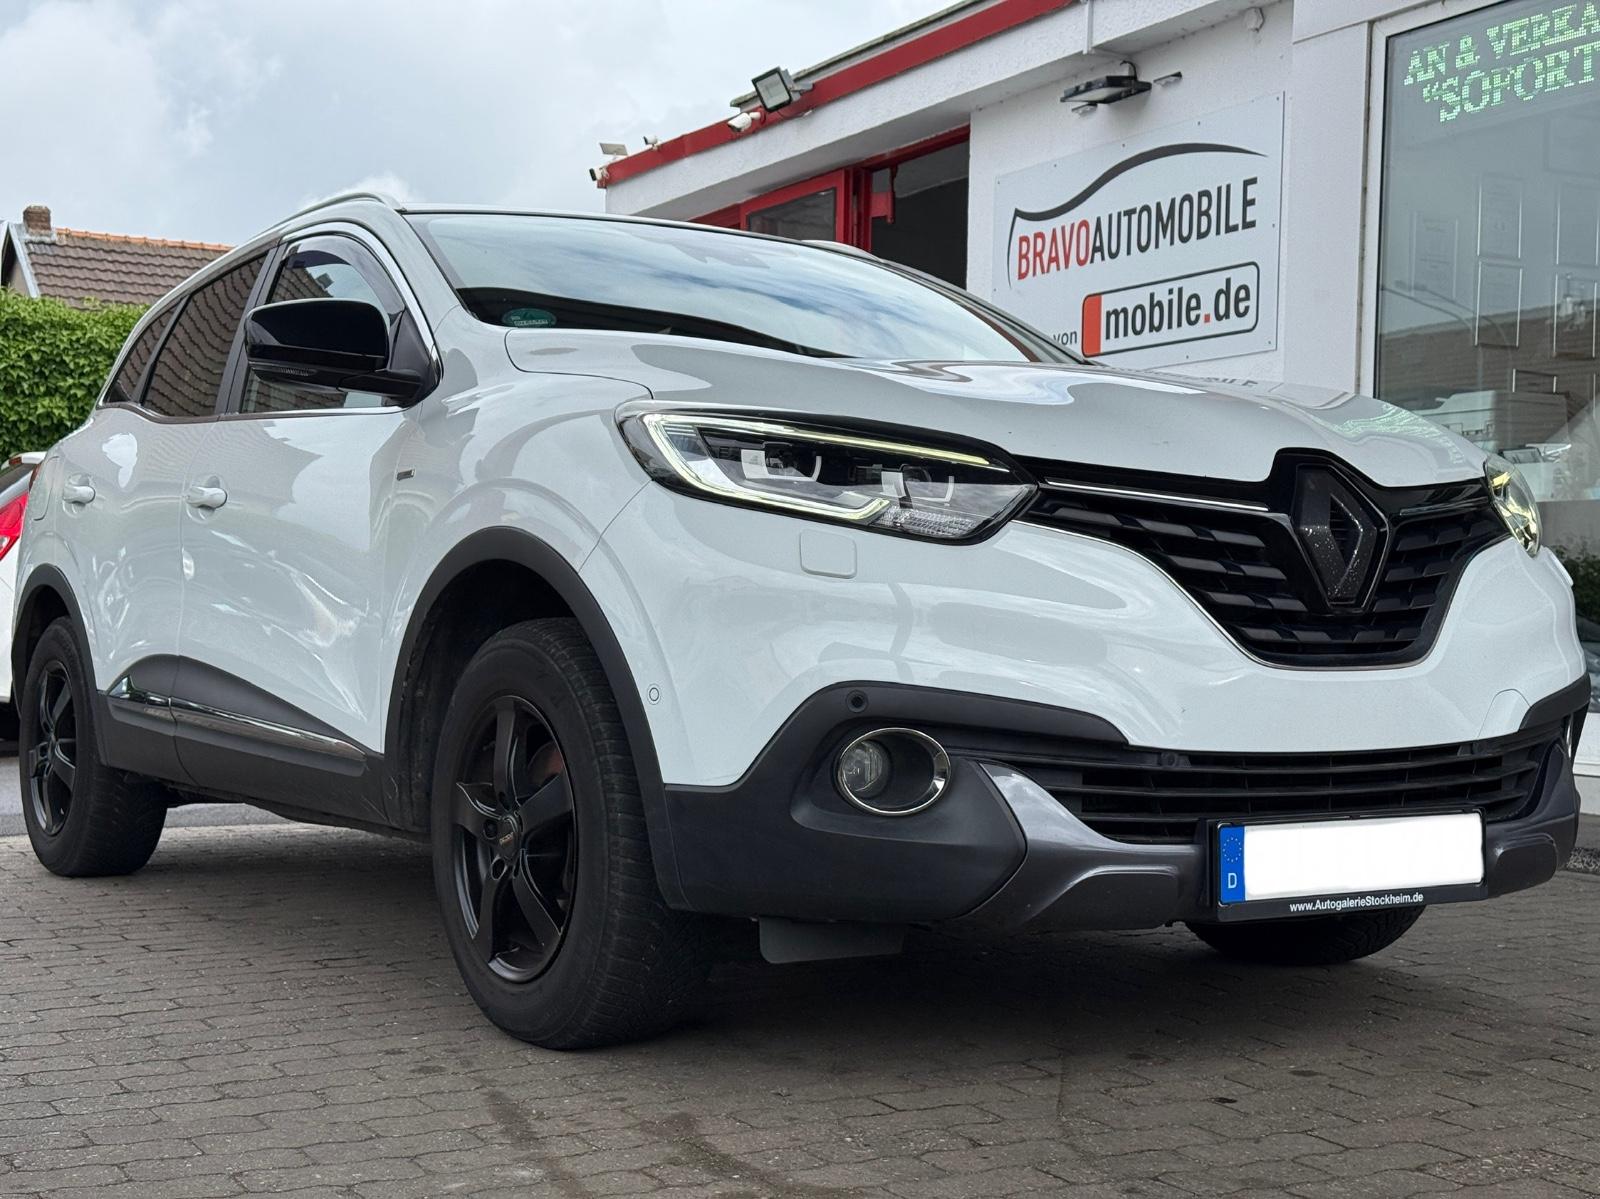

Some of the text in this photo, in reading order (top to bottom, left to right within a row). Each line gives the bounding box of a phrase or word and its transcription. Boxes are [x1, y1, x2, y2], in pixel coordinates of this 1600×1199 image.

[1105, 277, 1251, 340] mobile.de
[1227, 873, 1238, 889] D
[1289, 892, 1424, 912] www.AutogalerieStockheim.de
